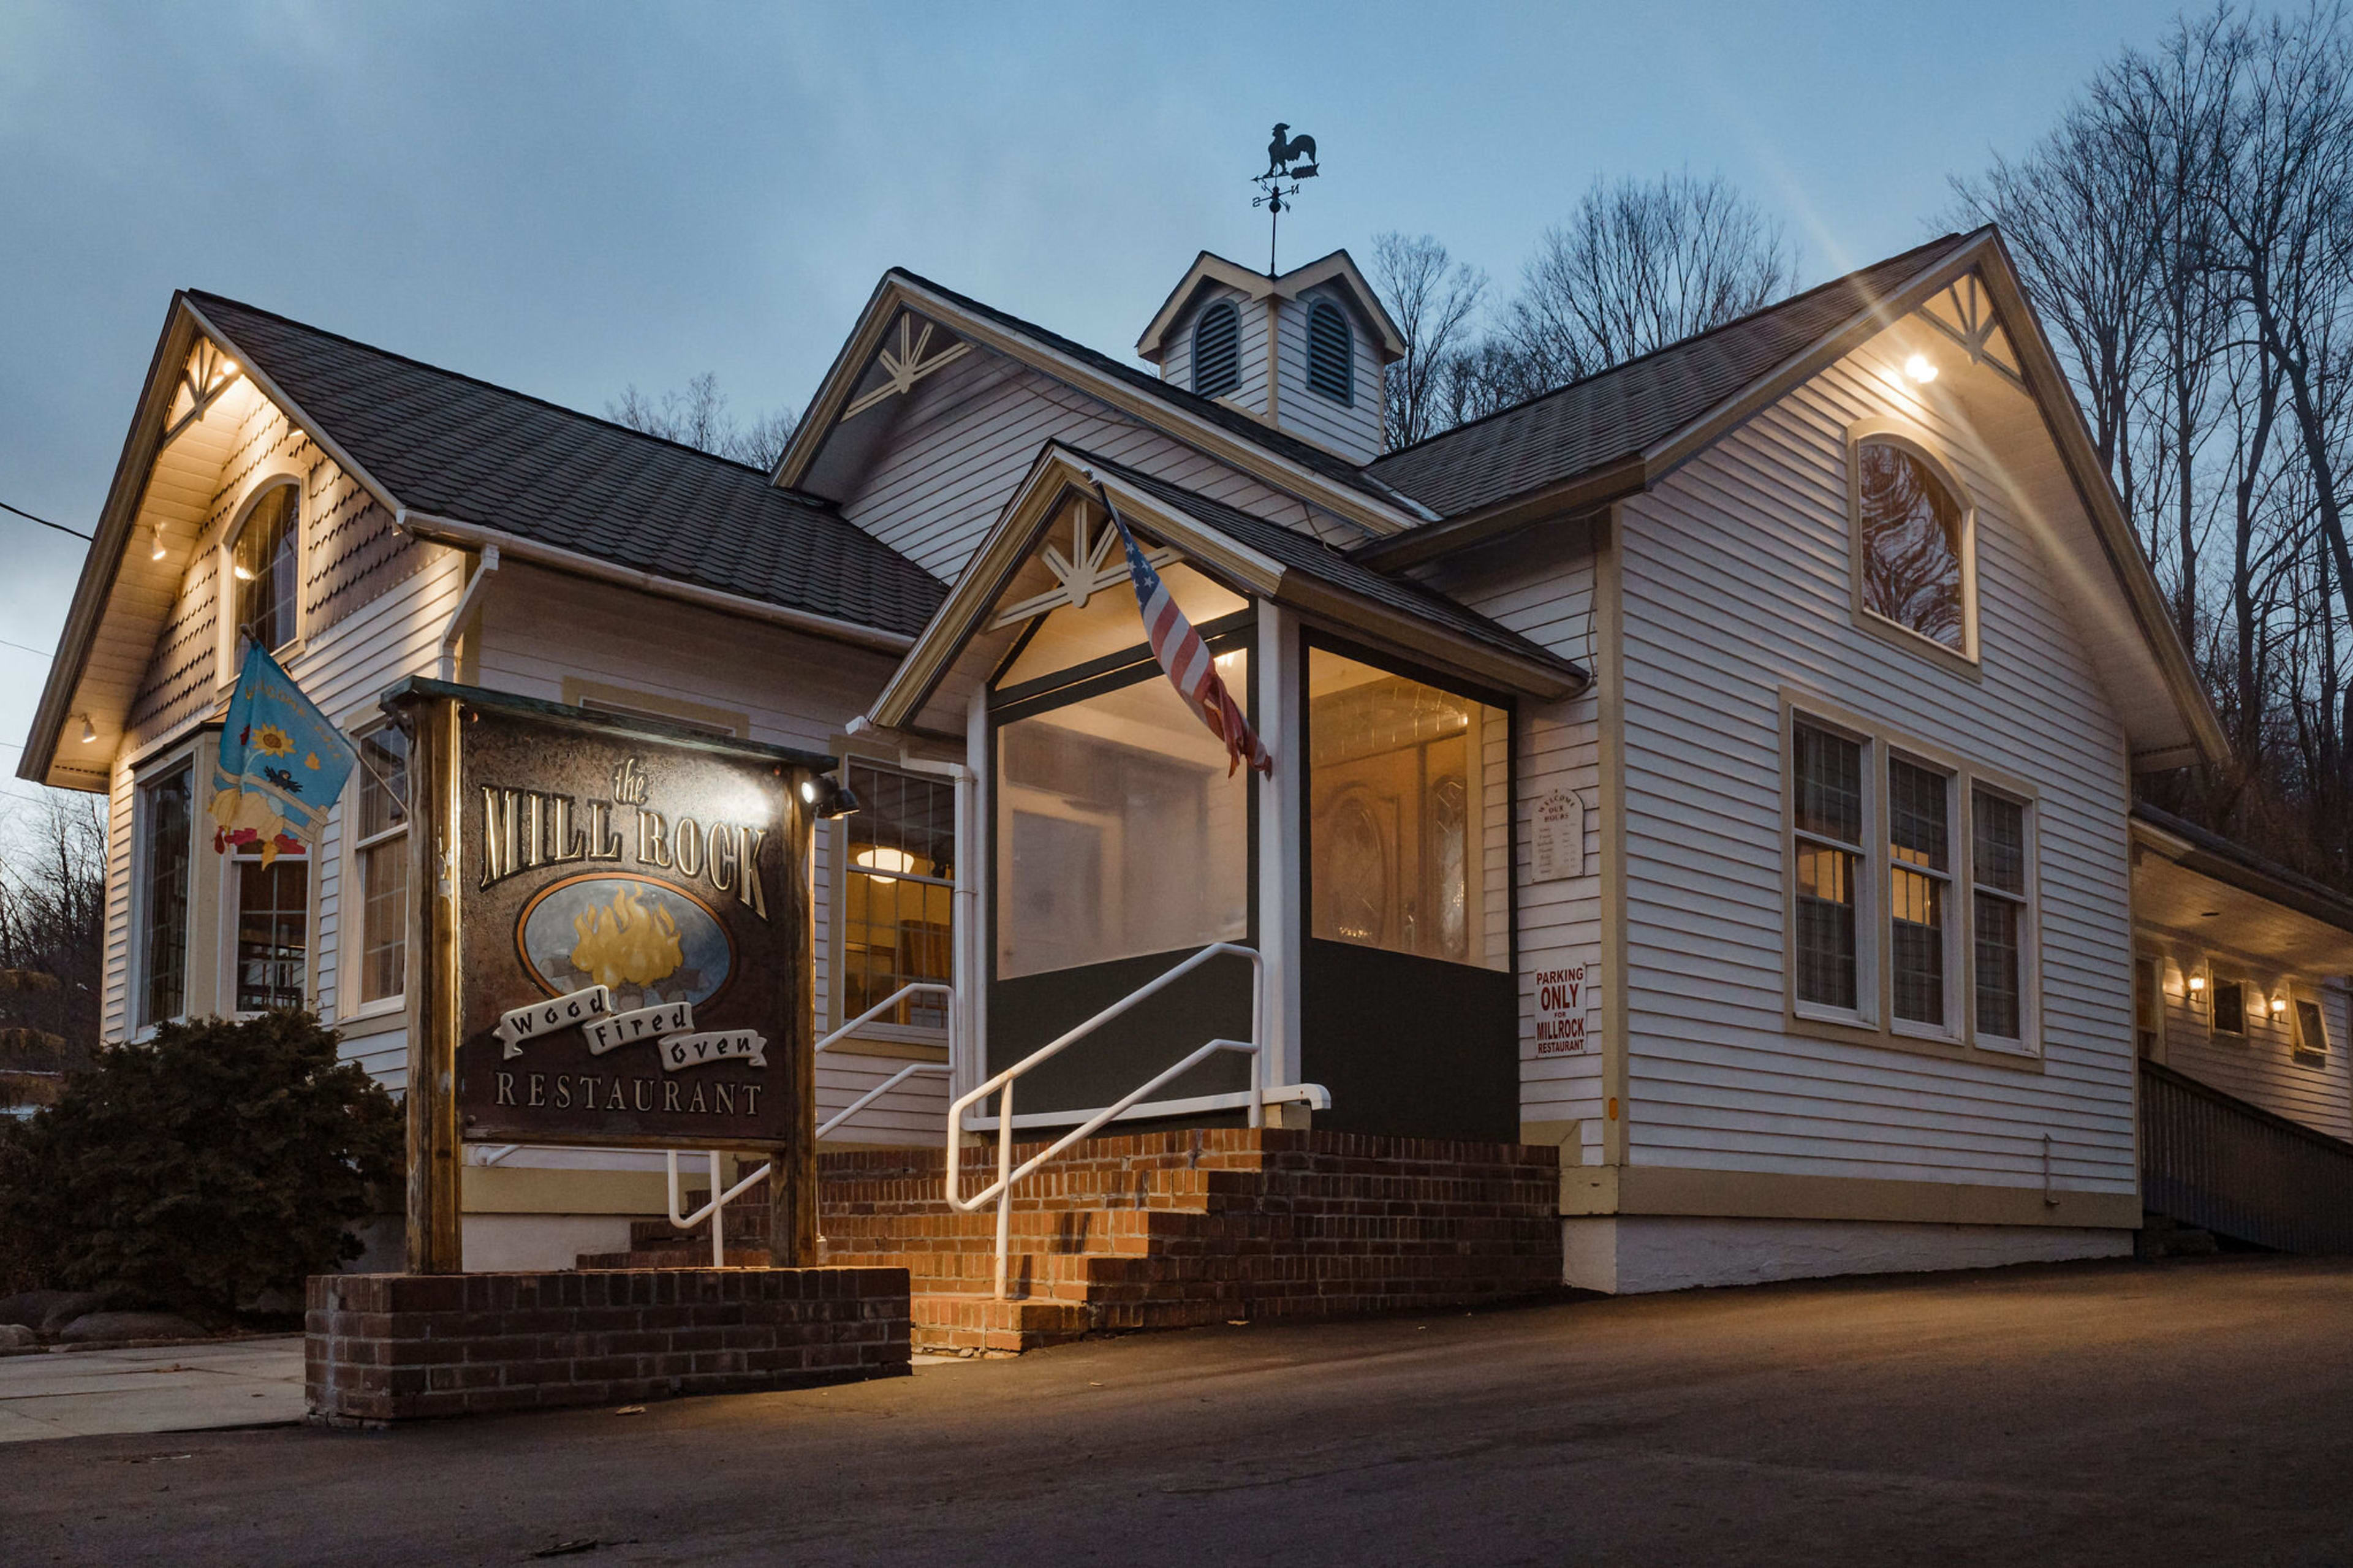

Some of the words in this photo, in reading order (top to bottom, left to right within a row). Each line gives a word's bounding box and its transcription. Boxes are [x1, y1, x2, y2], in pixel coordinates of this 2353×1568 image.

[615, 758, 648, 804] the
[480, 785, 621, 889] MILL
[637, 811, 769, 920] ROCK
[1537, 968, 1583, 985] PARKING
[1541, 983, 1578, 1010] ONLY
[510, 989, 606, 1035] Wood
[596, 1004, 687, 1048] Fired
[670, 1034, 752, 1064] Oven
[1537, 1018, 1584, 1041] MILLROCK
[1538, 1039, 1584, 1054] RESTAURANT
[496, 1072, 762, 1115] RESTAURANT
